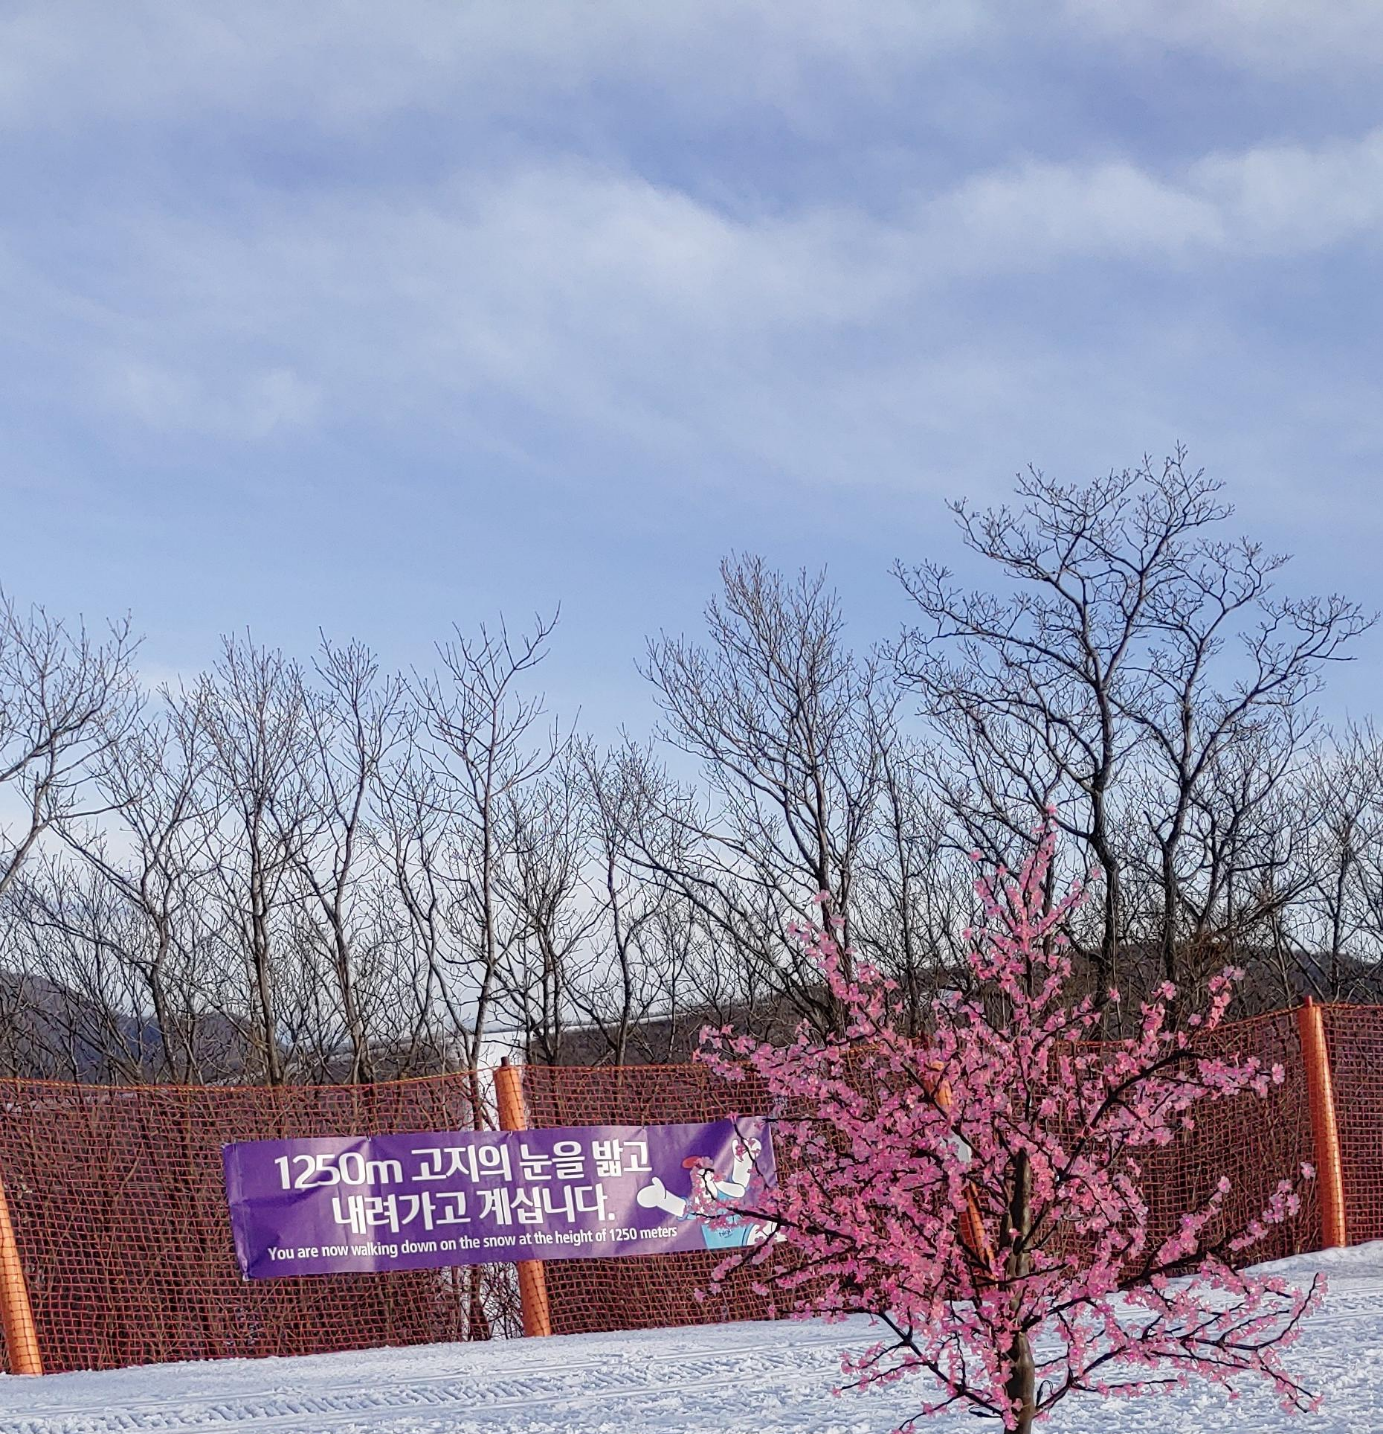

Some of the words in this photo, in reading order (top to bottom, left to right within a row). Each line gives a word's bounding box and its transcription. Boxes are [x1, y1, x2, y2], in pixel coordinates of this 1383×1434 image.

[274, 1152, 403, 1190] 1250m
[411, 1144, 512, 1183] 고지의
[519, 1141, 585, 1181] 눈을
[592, 1139, 652, 1178] 밟고
[332, 1191, 471, 1234] 내려가고
[476, 1183, 615, 1226] 계십니다.
[268, 1247, 294, 1261] You
[297, 1247, 319, 1258] are
[322, 1246, 349, 1257] now
[351, 1242, 398, 1259] walking
[401, 1239, 436, 1254] down
[440, 1240, 456, 1250] on
[460, 1235, 480, 1249] the
[483, 1235, 516, 1248] snow
[519, 1233, 532, 1245] at
[534, 1231, 554, 1244] the
[555, 1229, 593, 1247] height
[595, 1228, 607, 1242] of
[609, 1228, 637, 1241] 1250
[640, 1226, 677, 1239] meters
